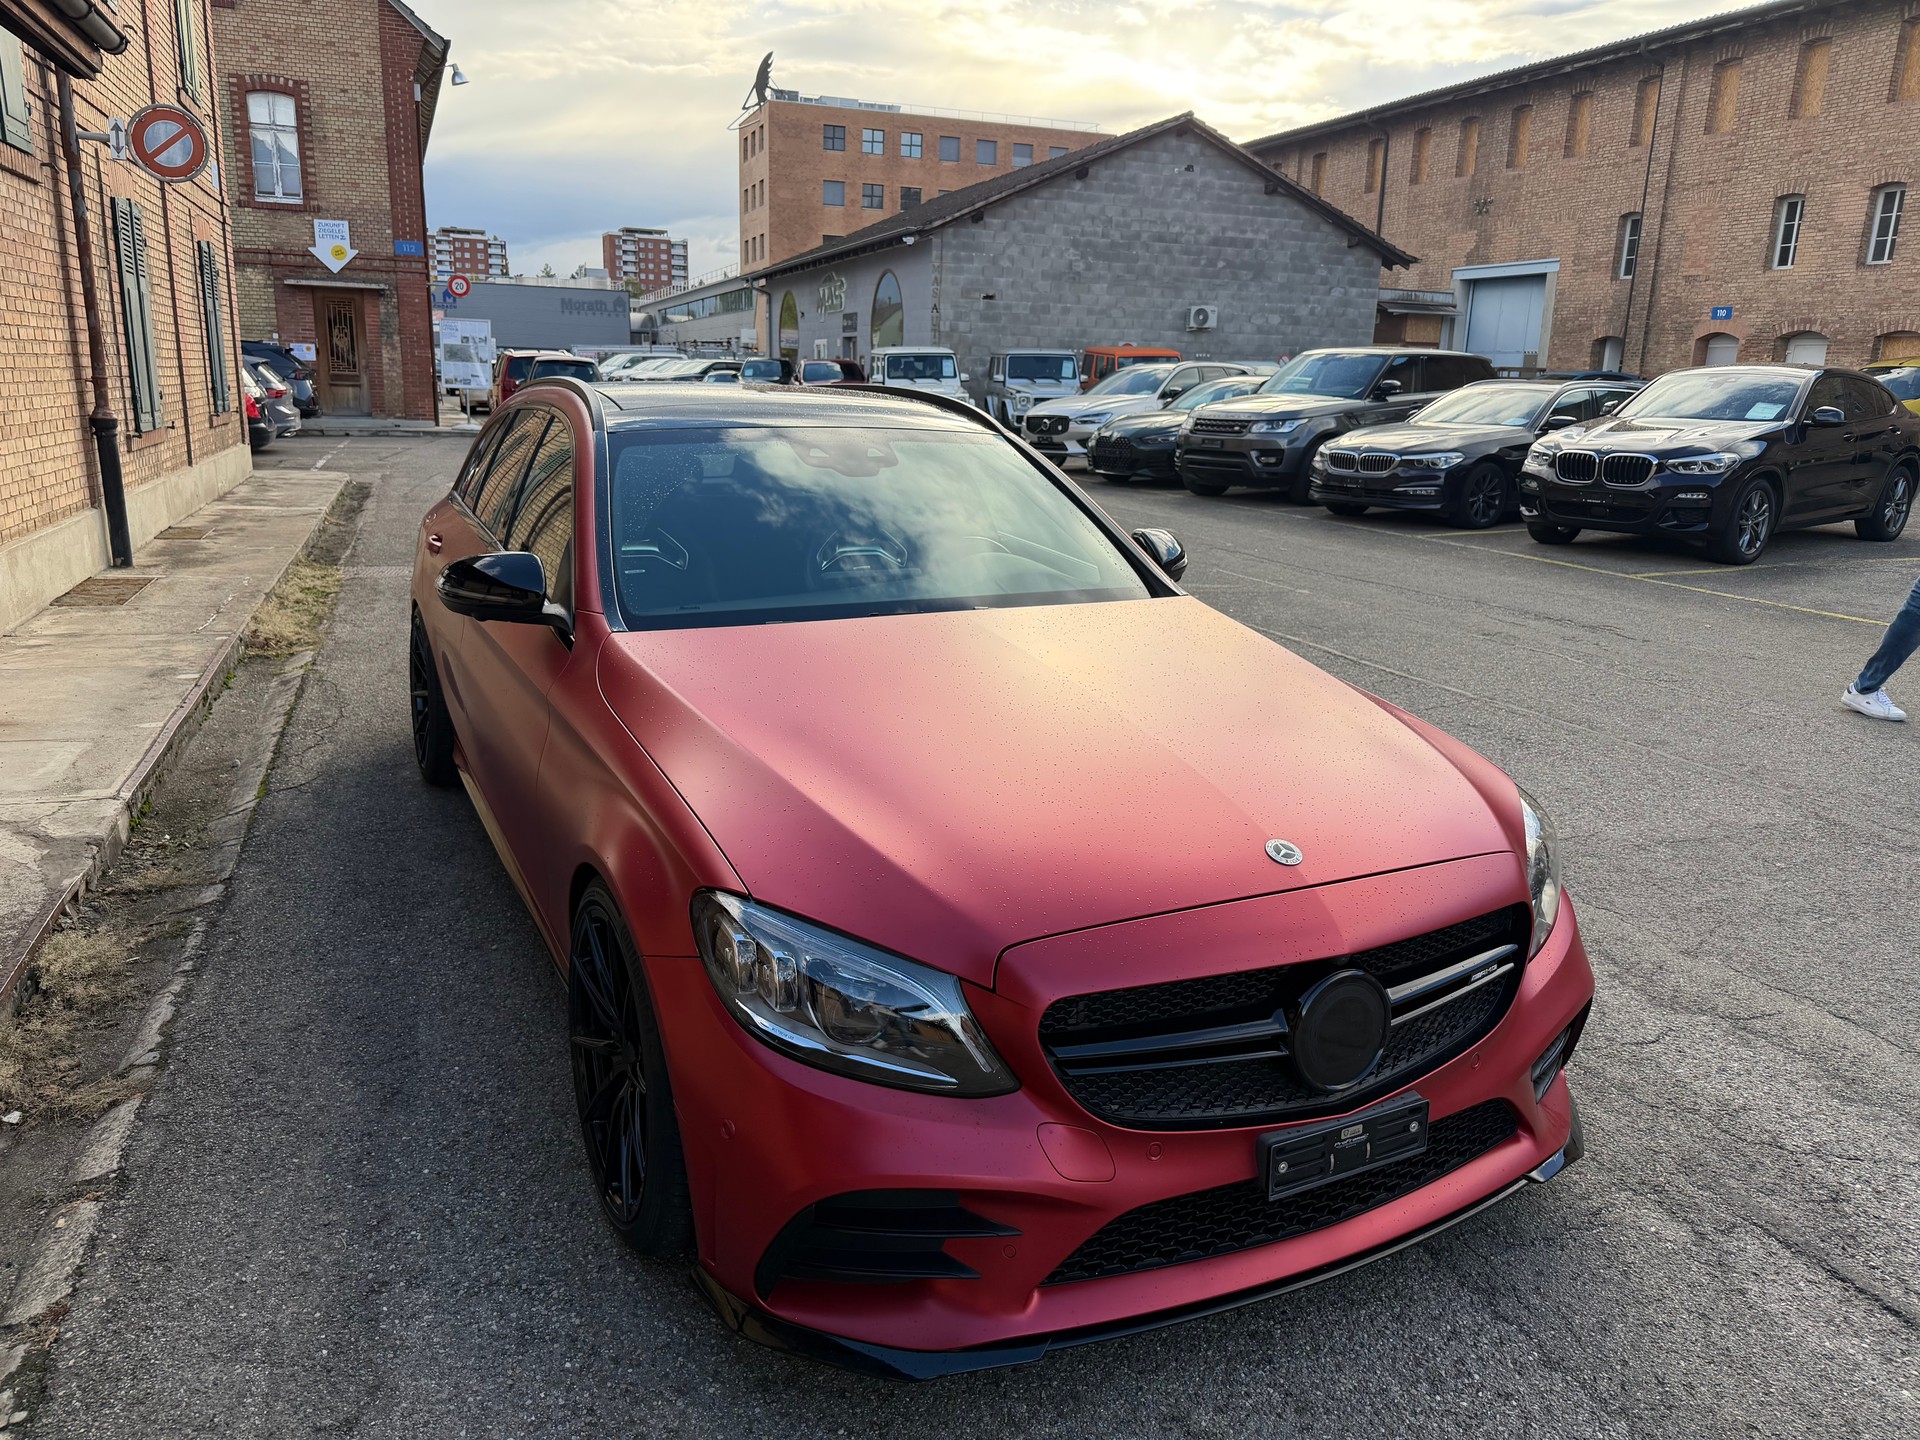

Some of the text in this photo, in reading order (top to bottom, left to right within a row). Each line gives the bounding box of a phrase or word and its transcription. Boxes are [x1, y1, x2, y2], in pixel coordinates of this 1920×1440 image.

[317, 221, 345, 229] ZUKUNFT
[402, 243, 416, 253] 112
[454, 281, 465, 291] 20
[560, 297, 608, 312] Morath
[1716, 309, 1727, 317] 110
